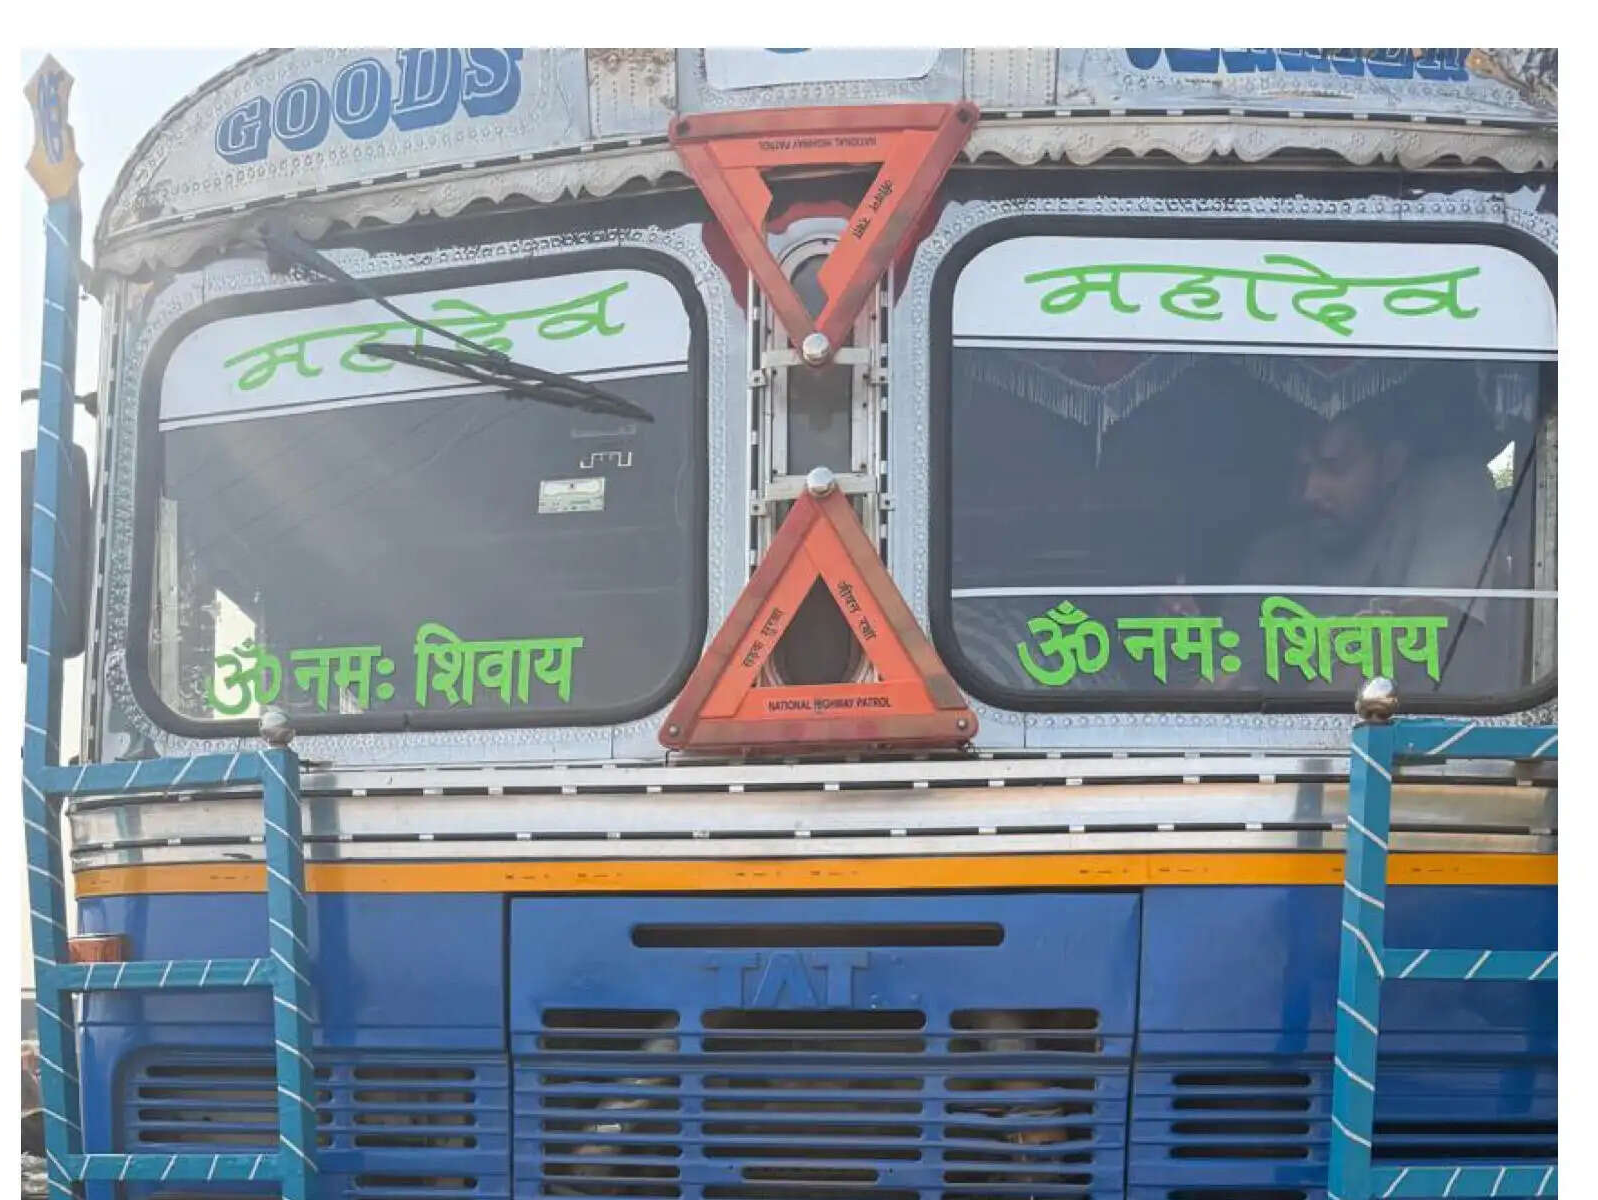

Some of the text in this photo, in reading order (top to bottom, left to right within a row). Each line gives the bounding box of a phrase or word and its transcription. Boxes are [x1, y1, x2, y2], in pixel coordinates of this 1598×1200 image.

[215, 48, 522, 164] GOODS
[1023, 254, 1481, 337] महादेव
[290, 644, 395, 712] नमः
[414, 622, 584, 708] शिवाय
[1118, 616, 1240, 683] नमः
[1259, 596, 1448, 684] शिवाय
[768, 700, 811, 712] NATIONAL
[857, 697, 891, 708] PATROL
